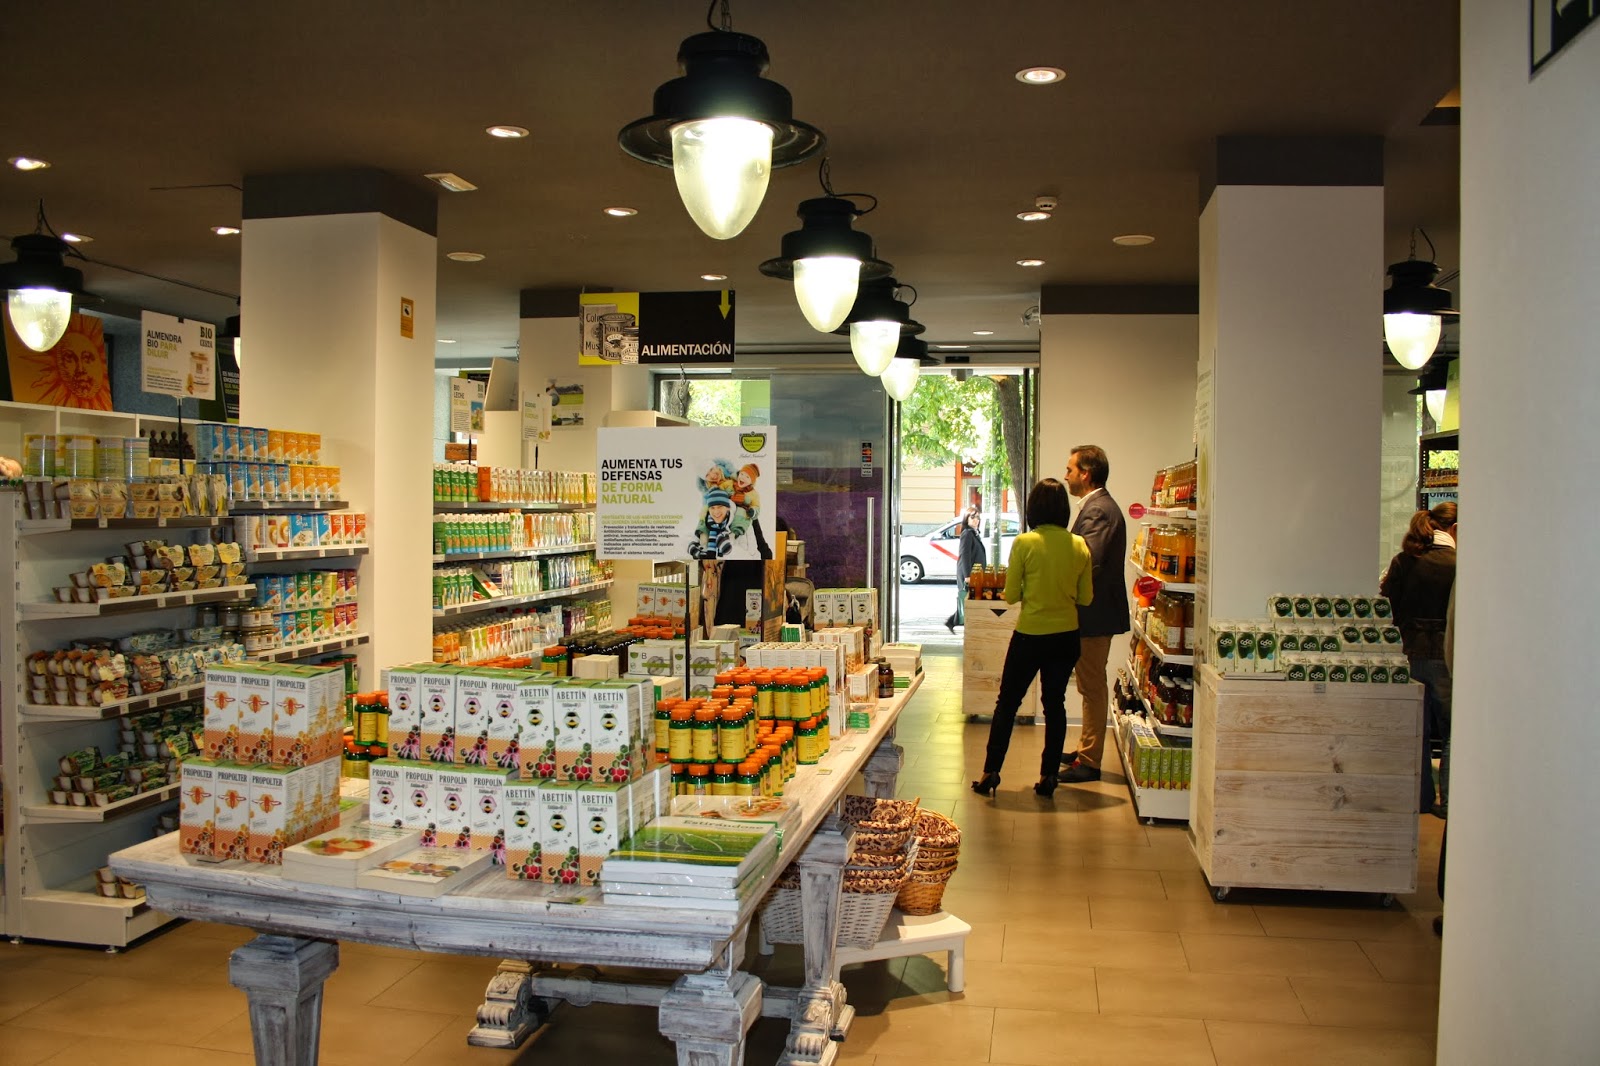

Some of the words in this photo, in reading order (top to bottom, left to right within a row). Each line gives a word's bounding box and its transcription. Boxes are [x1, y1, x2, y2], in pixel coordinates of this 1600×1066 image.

[147, 330, 182, 344] ALMENDRA
[200, 326, 212, 339] BIO
[147, 339, 158, 348] BIO
[160, 342, 177, 352] PARA
[641, 341, 731, 356] ALIMENTACIÓN
[147, 348, 168, 359] DILUIR
[602, 459, 657, 470] AUMENTA
[660, 458, 683, 468] TUS
[602, 470, 662, 481] DEFENSAS
[602, 482, 617, 492] DE
[620, 482, 663, 492] FORMA
[602, 494, 655, 504] NATURAL
[207, 673, 237, 684] PROPOLTER
[241, 676, 270, 687] PROPOLTER
[276, 679, 306, 690] PROPOLTER
[520, 688, 549, 697] ABETTÍN
[557, 690, 586, 700] ABETTÍN
[593, 692, 623, 701] ABETTÍN
[183, 767, 213, 779] PROPOLTER
[218, 771, 248, 782] PROPOLTER
[252, 775, 283, 786] PROPOLTER
[506, 789, 535, 798] ABETTÍN
[542, 792, 572, 802] ABETTÍN
[582, 794, 613, 804] ABETTÍN
